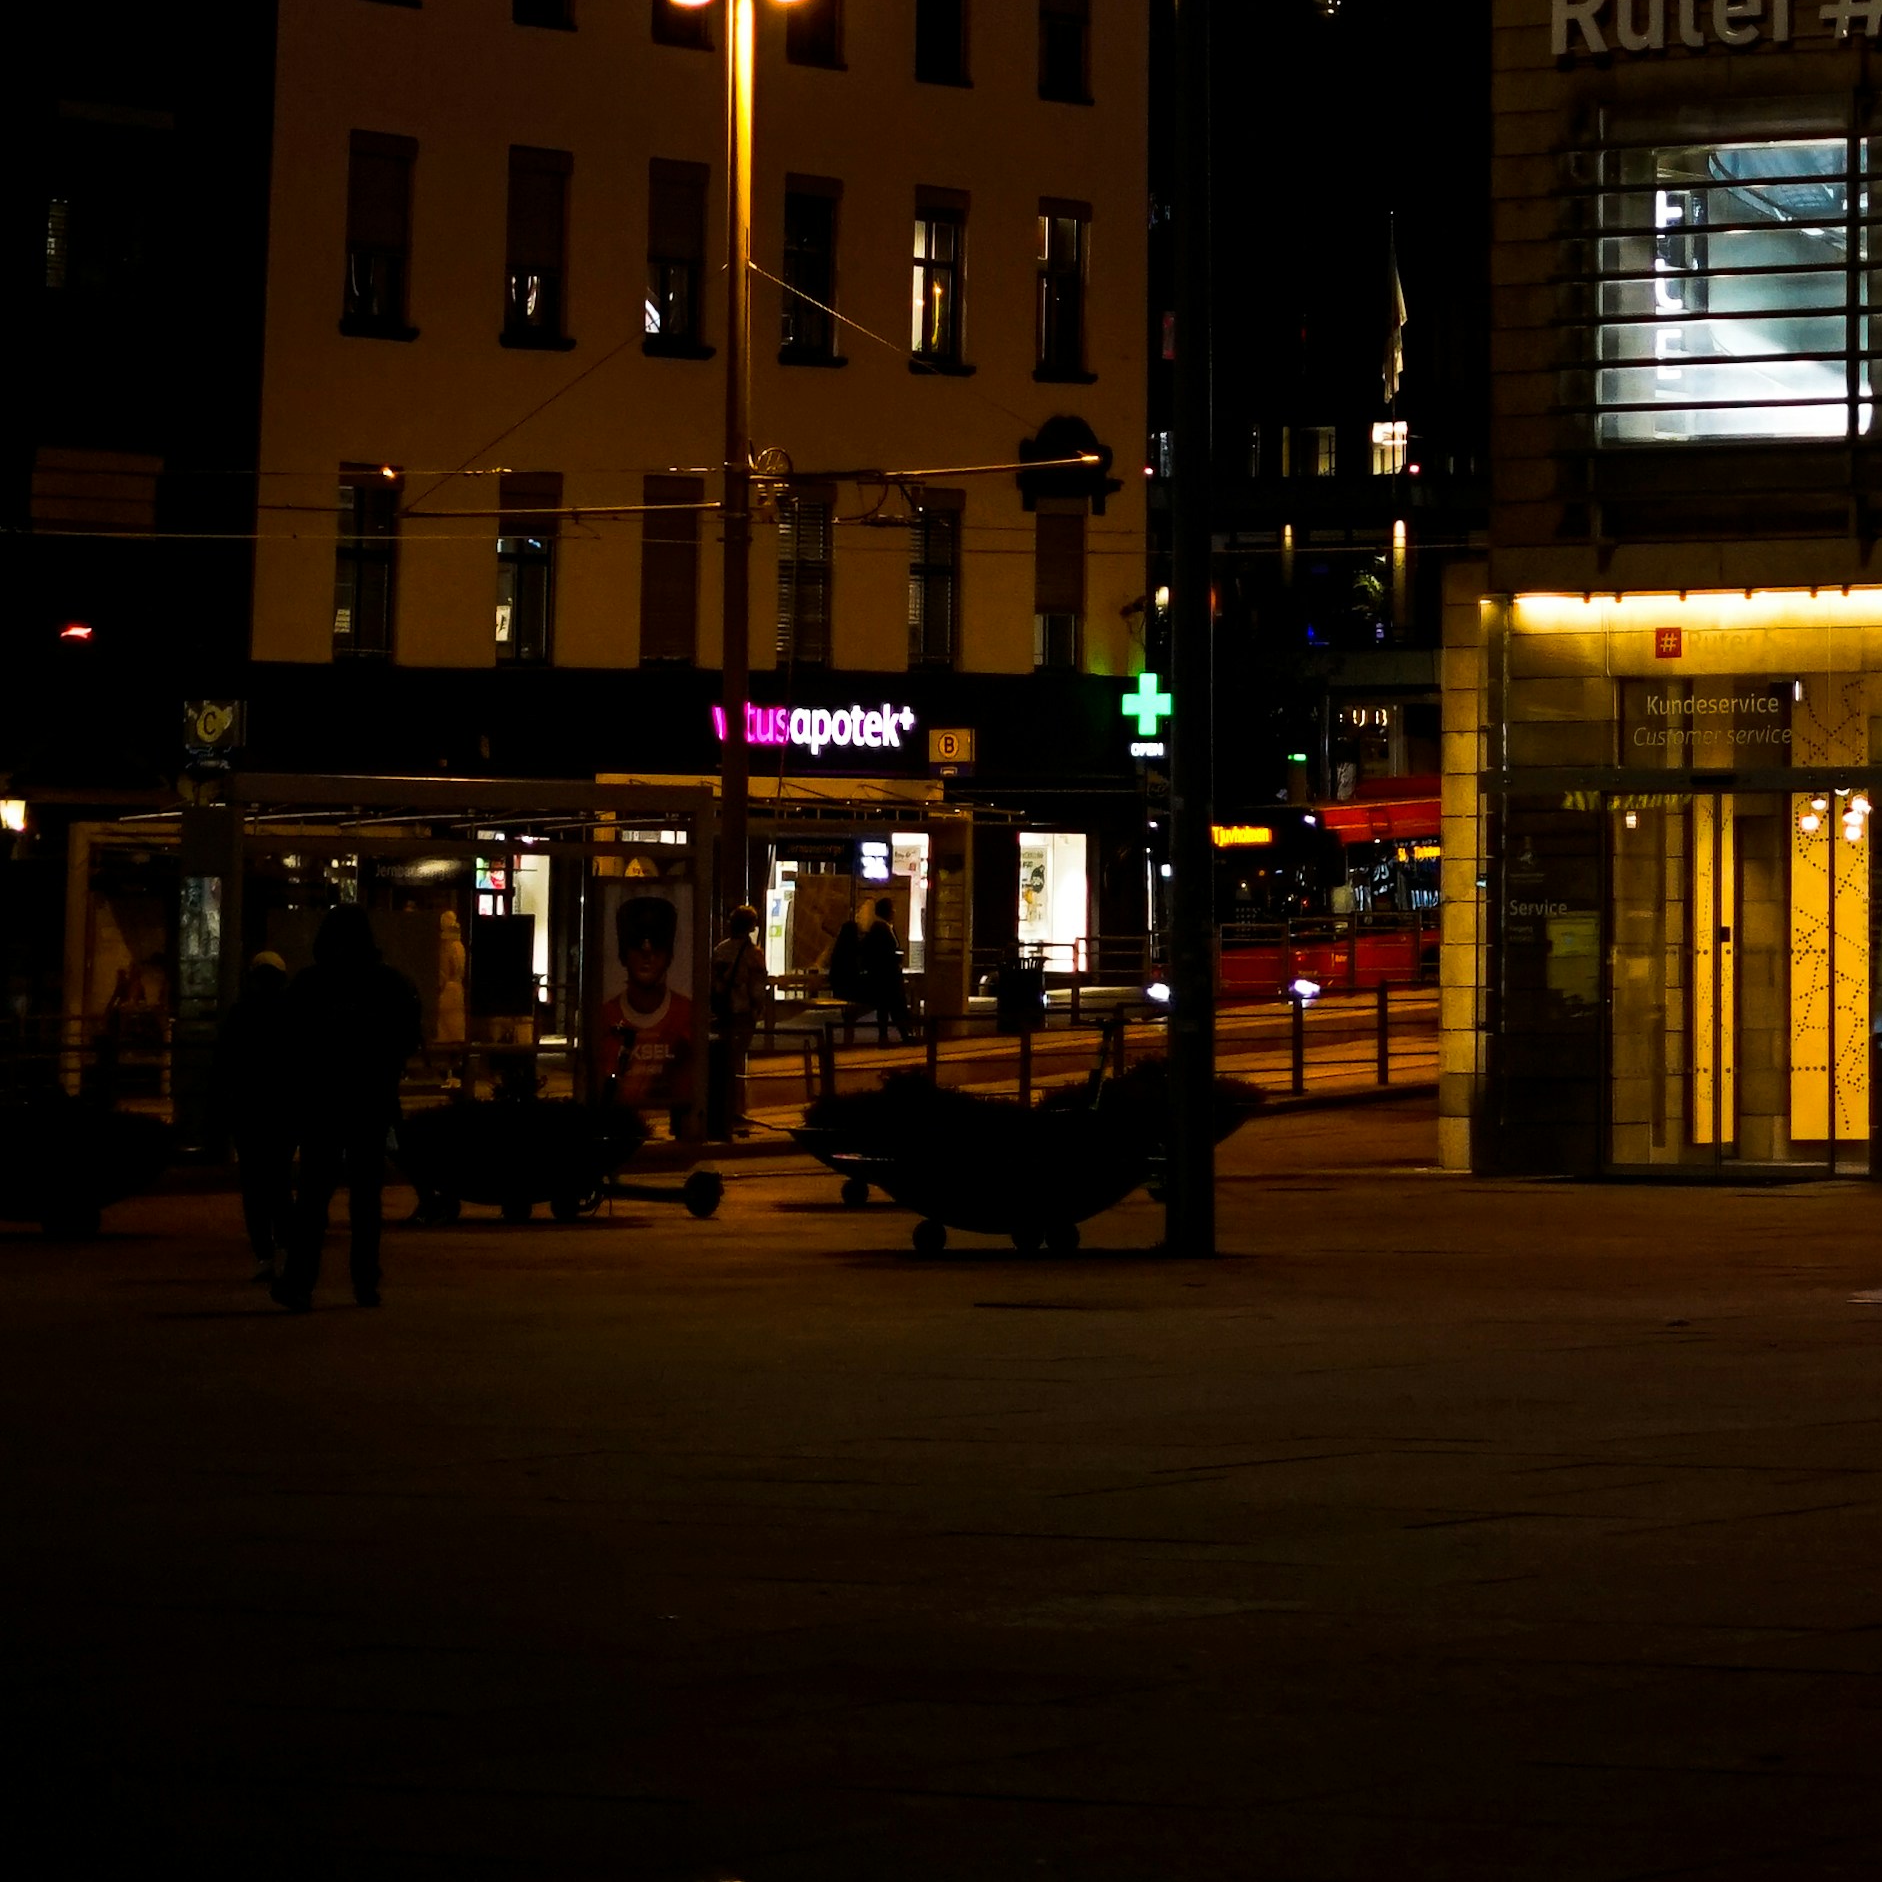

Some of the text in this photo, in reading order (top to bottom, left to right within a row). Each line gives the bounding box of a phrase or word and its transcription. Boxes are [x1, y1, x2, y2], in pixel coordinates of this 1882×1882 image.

[1647, 693, 1779, 715] Kundeservice
[1634, 724, 1792, 746] Customer service
[943, 736, 955, 754] B
[1131, 742, 1164, 757] OPEN
[1509, 899, 1567, 916] Service
